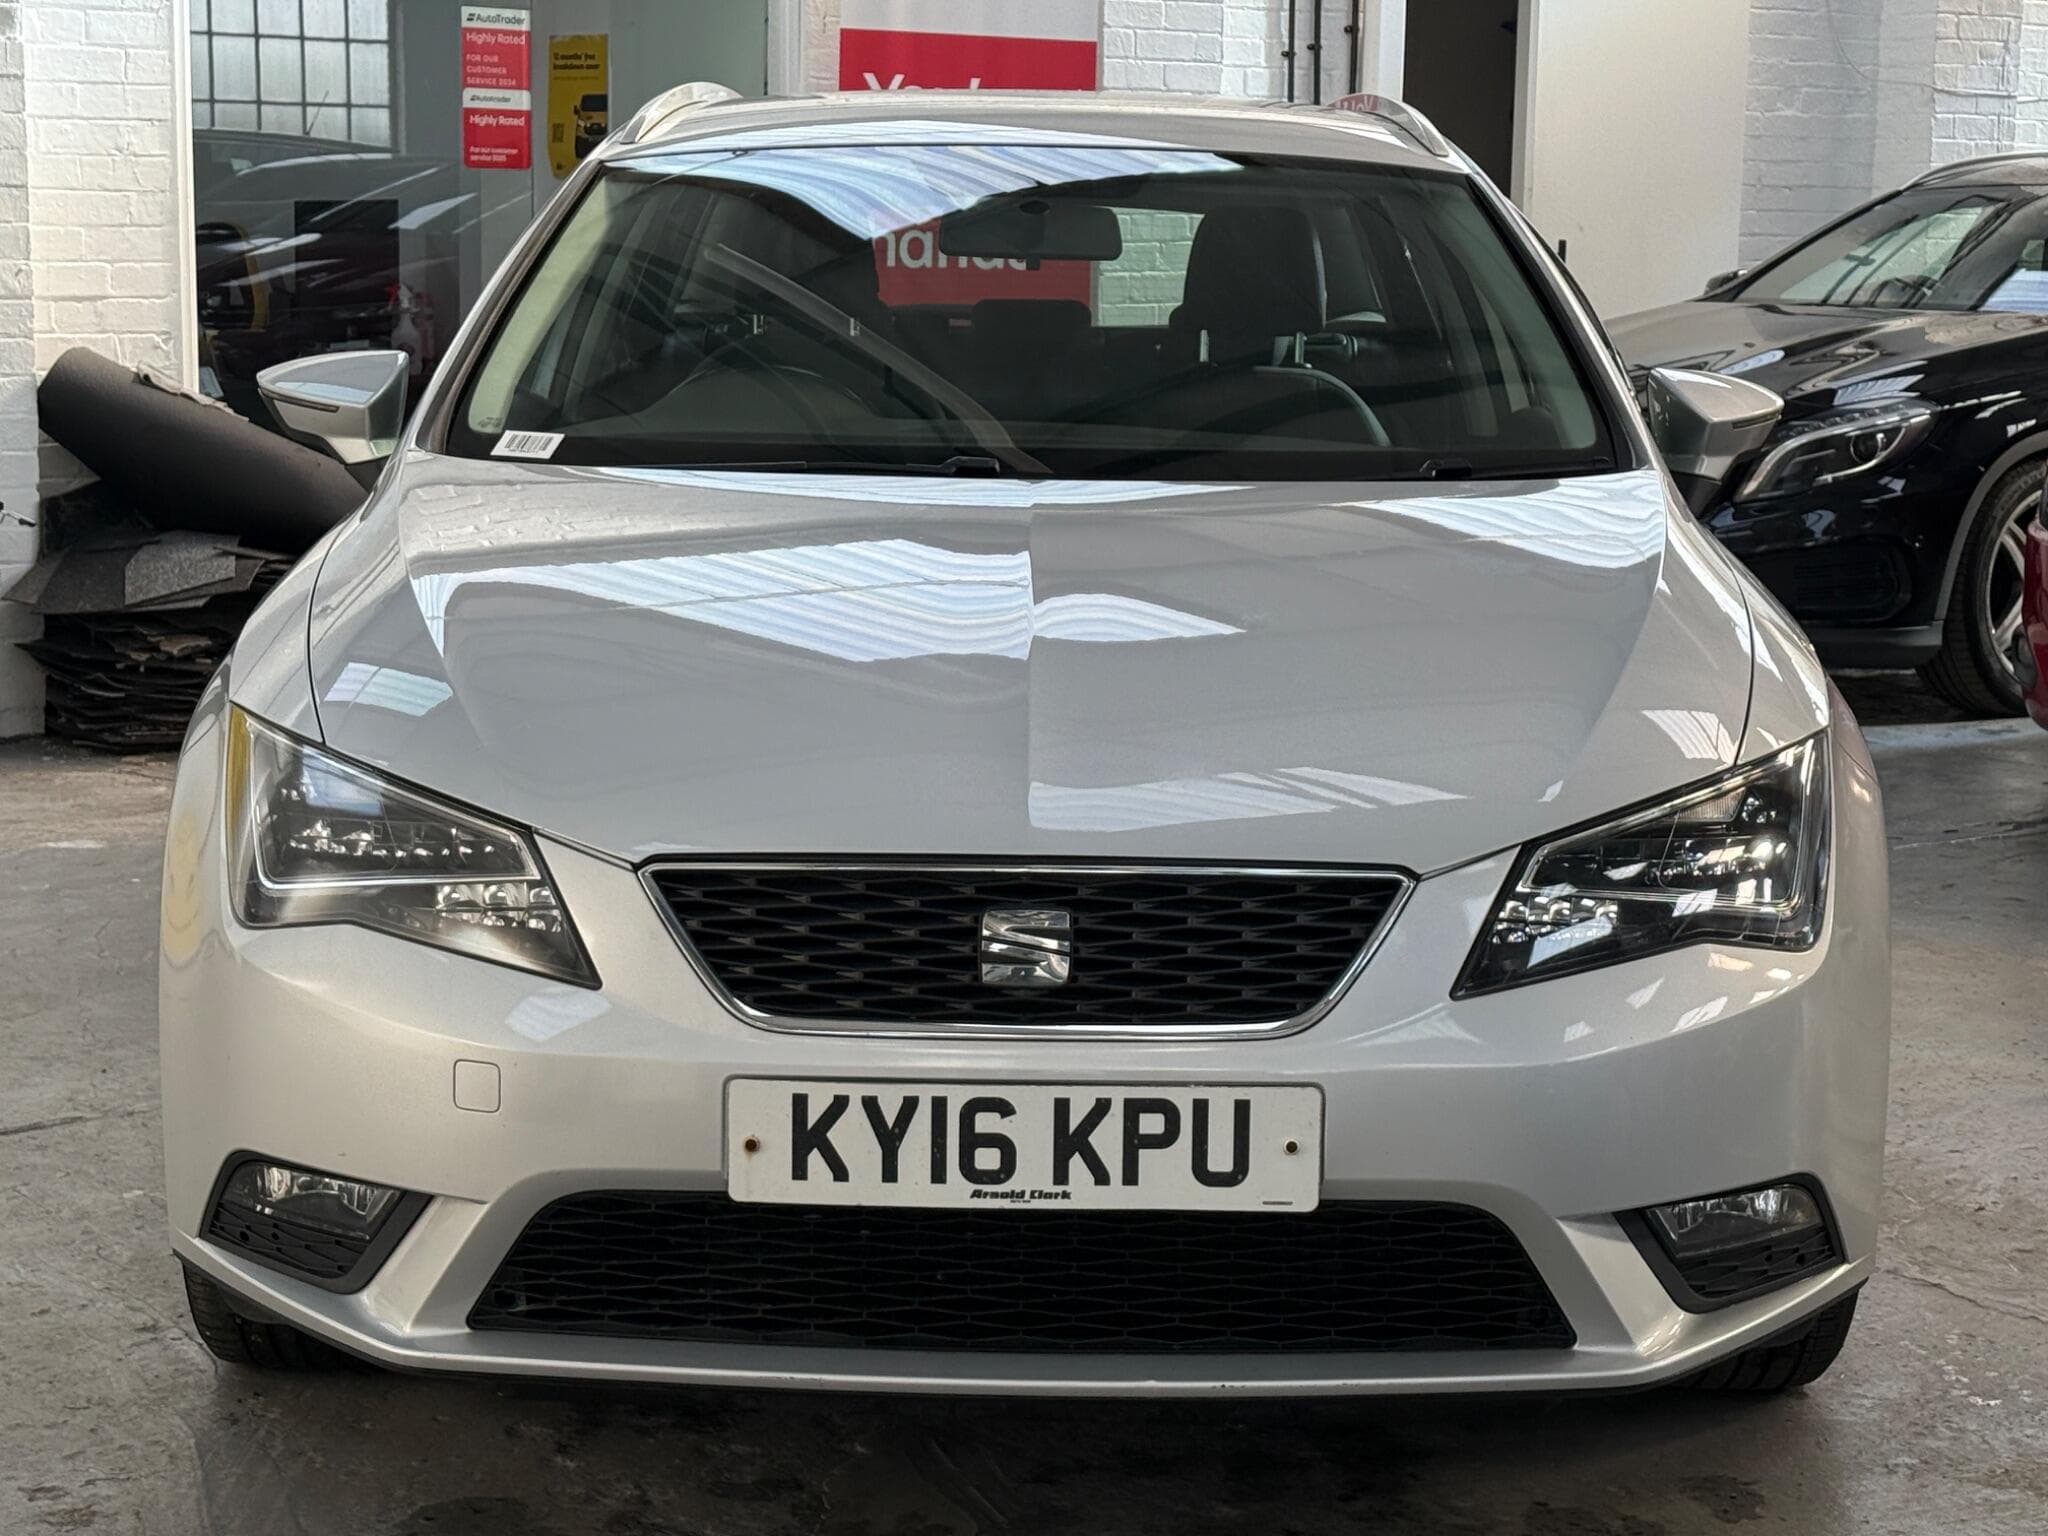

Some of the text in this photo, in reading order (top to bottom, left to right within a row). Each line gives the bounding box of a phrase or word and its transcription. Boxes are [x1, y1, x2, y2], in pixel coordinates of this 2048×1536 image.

[475, 13, 525, 24] AutoTrader
[466, 32, 526, 46] Highly Rated
[466, 54, 481, 62] FOR
[466, 66, 507, 75] CUSTOMER
[466, 77, 497, 86] SERVICE
[469, 114, 525, 127] Highly Rated
[791, 1093, 1251, 1187] KY16 KPU
[969, 1189, 1072, 1200] Arnold Clark
